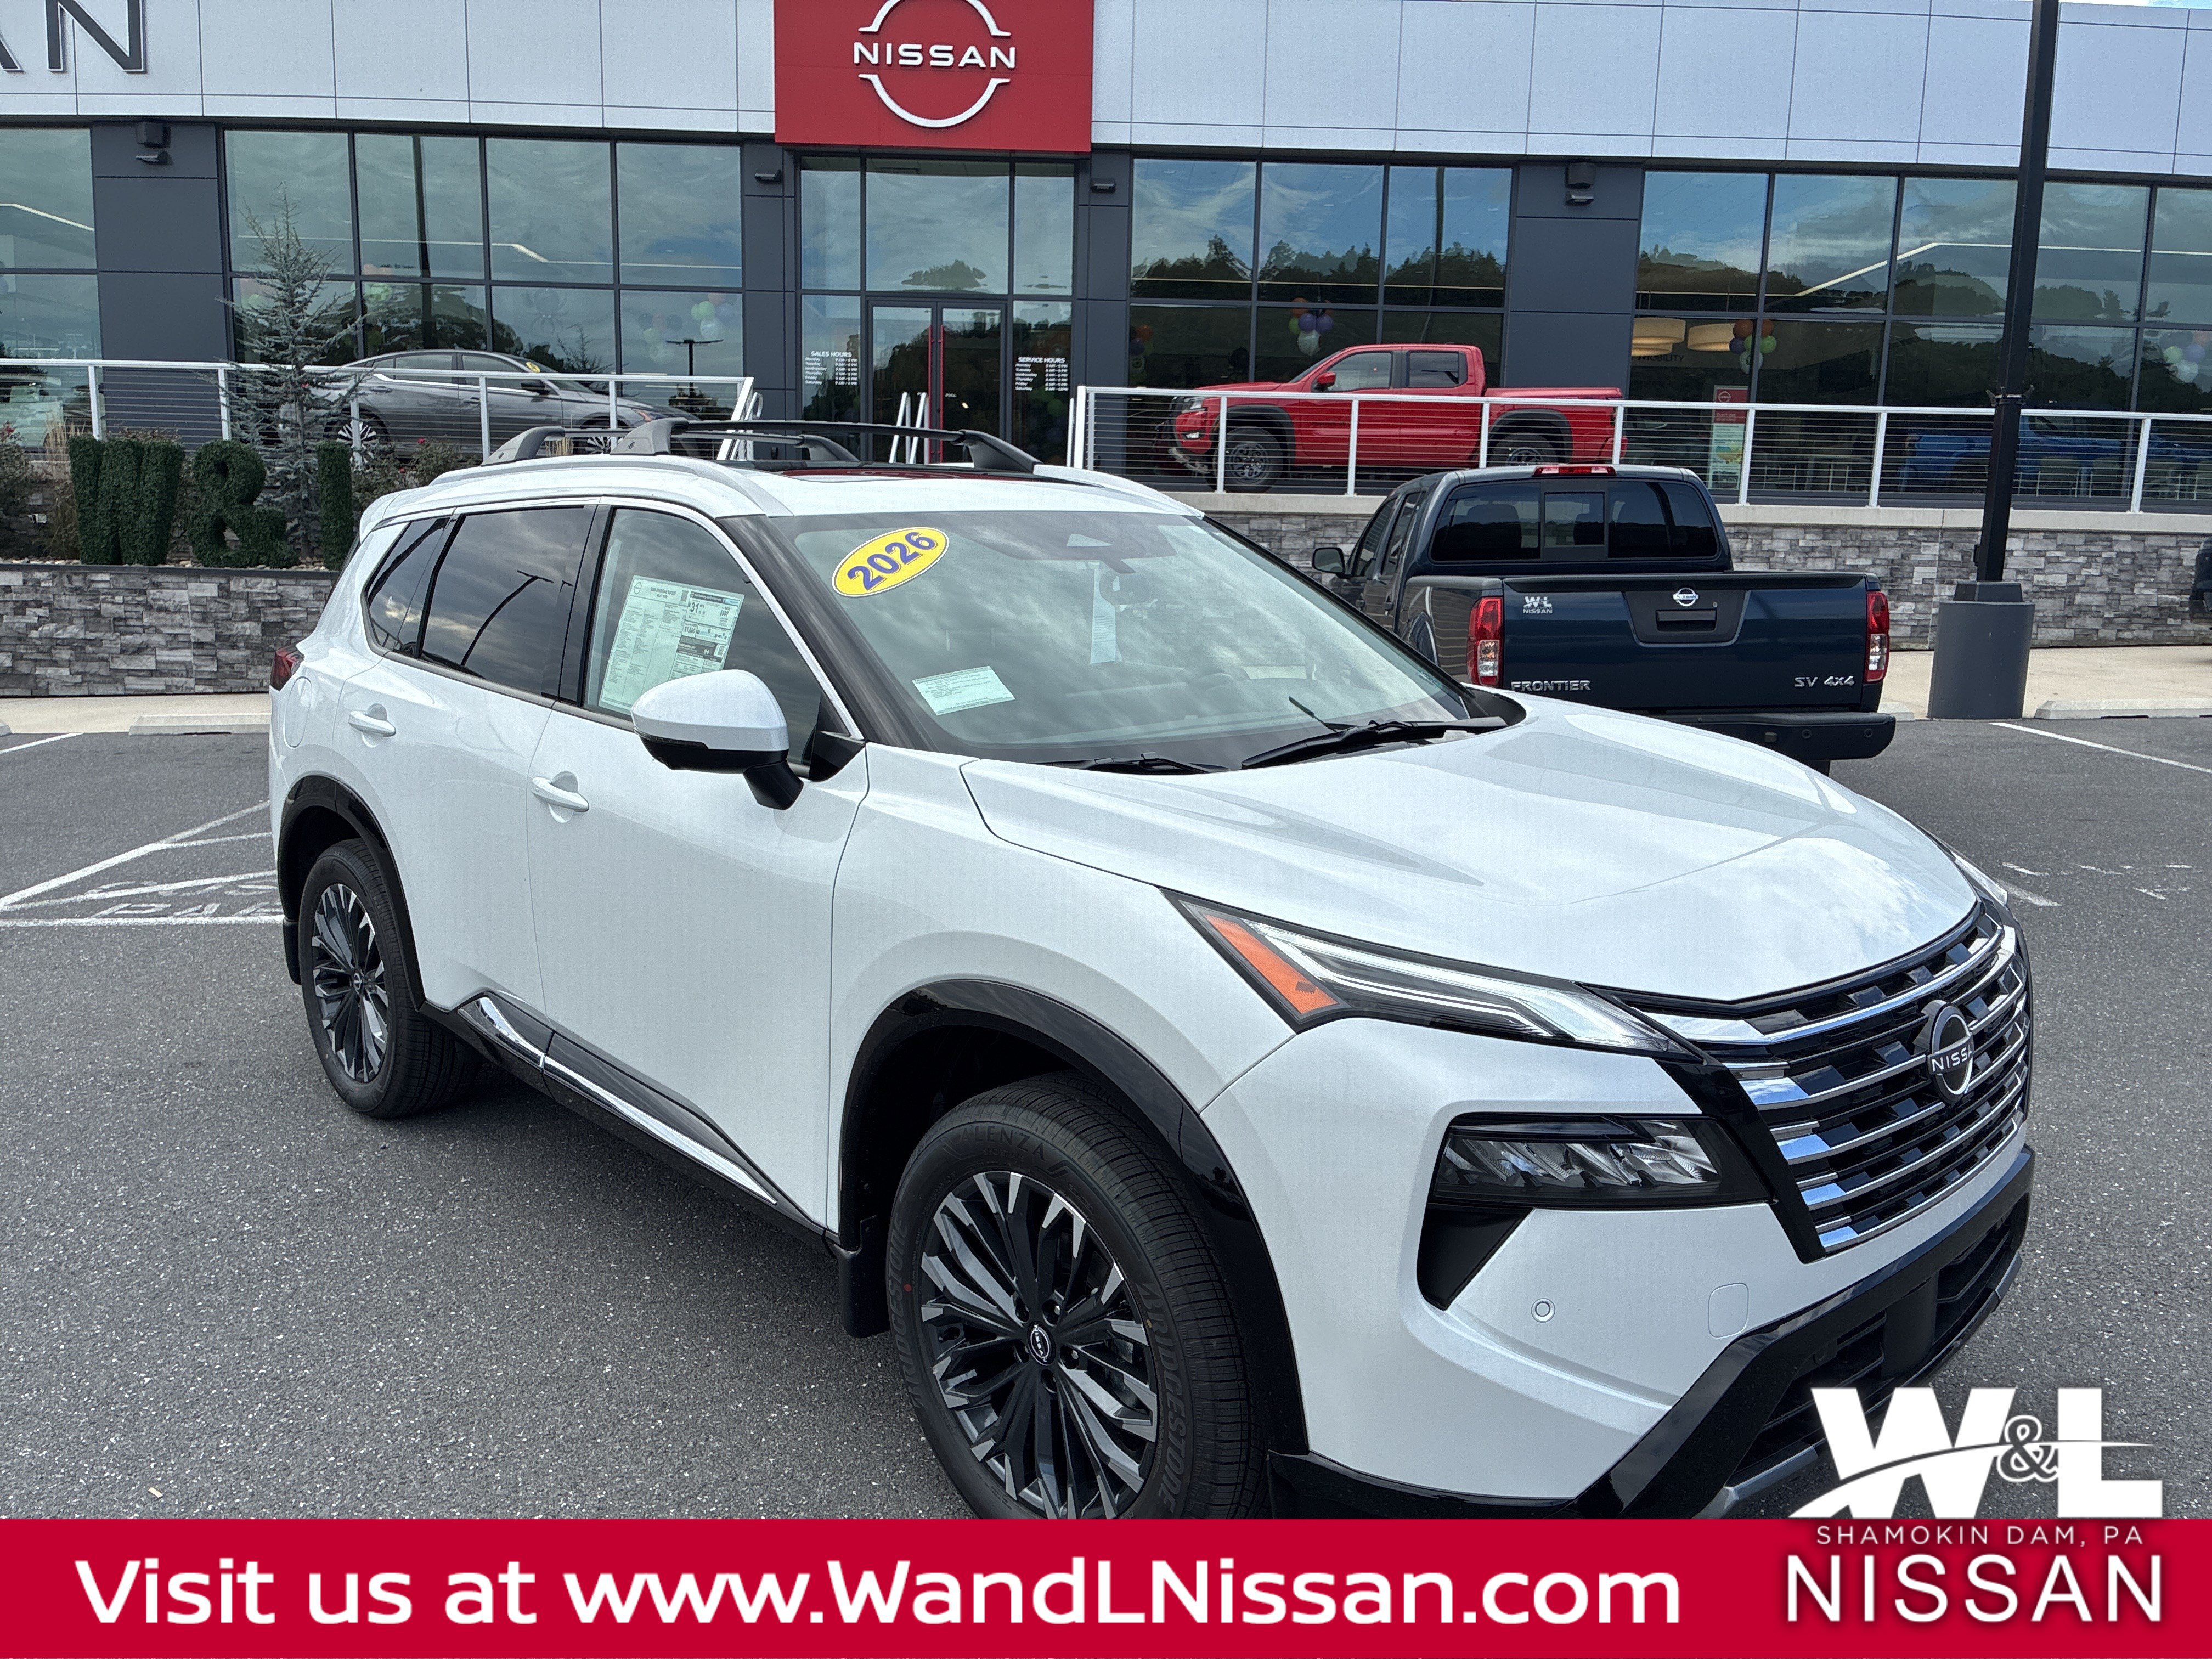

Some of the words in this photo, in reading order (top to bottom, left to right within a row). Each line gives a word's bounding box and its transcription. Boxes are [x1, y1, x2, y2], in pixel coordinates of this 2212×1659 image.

[854, 42, 1015, 69] NISSAN
[847, 532, 938, 591] 2026
[690, 602, 699, 613] 31
[1511, 680, 1591, 691] FRONTIER
[1795, 677, 1818, 687] SV
[1932, 1045, 1973, 1071] NISSA
[961, 1125, 1046, 1161] ALENZA
[889, 1213, 928, 1409] BRIDGESTONE
[1034, 1324, 1047, 1362] NISSAN
[1136, 1282, 1187, 1513] BRIDGESTONE
